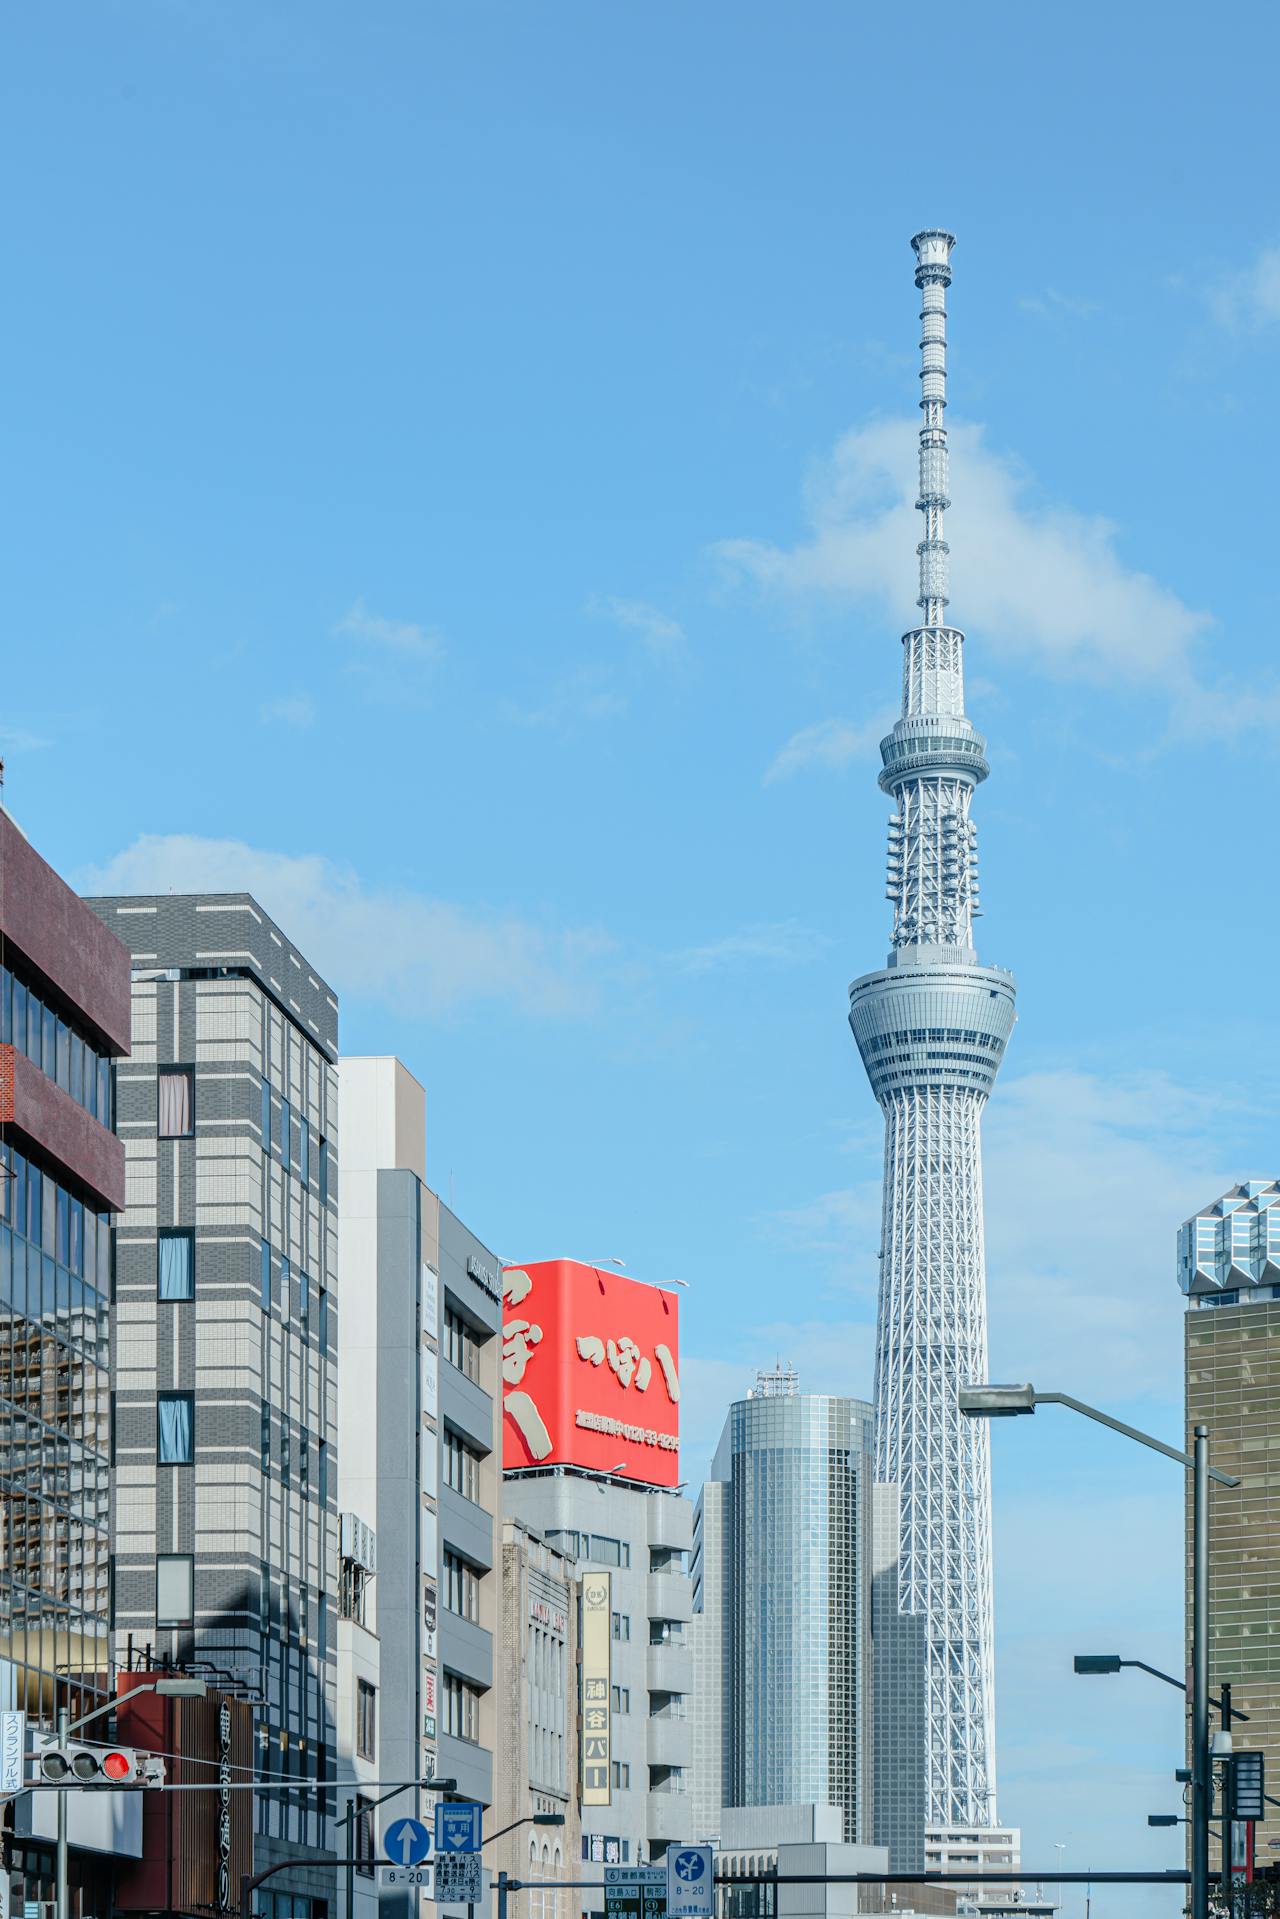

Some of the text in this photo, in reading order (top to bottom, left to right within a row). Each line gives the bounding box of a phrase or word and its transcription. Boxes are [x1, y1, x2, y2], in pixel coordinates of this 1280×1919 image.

[5, 1714, 18, 1789] スクランブル式
[586, 1680, 606, 1787] 神谷バー
[448, 1823, 470, 1833] 専用
[608, 1887, 637, 1897] 向島入口
